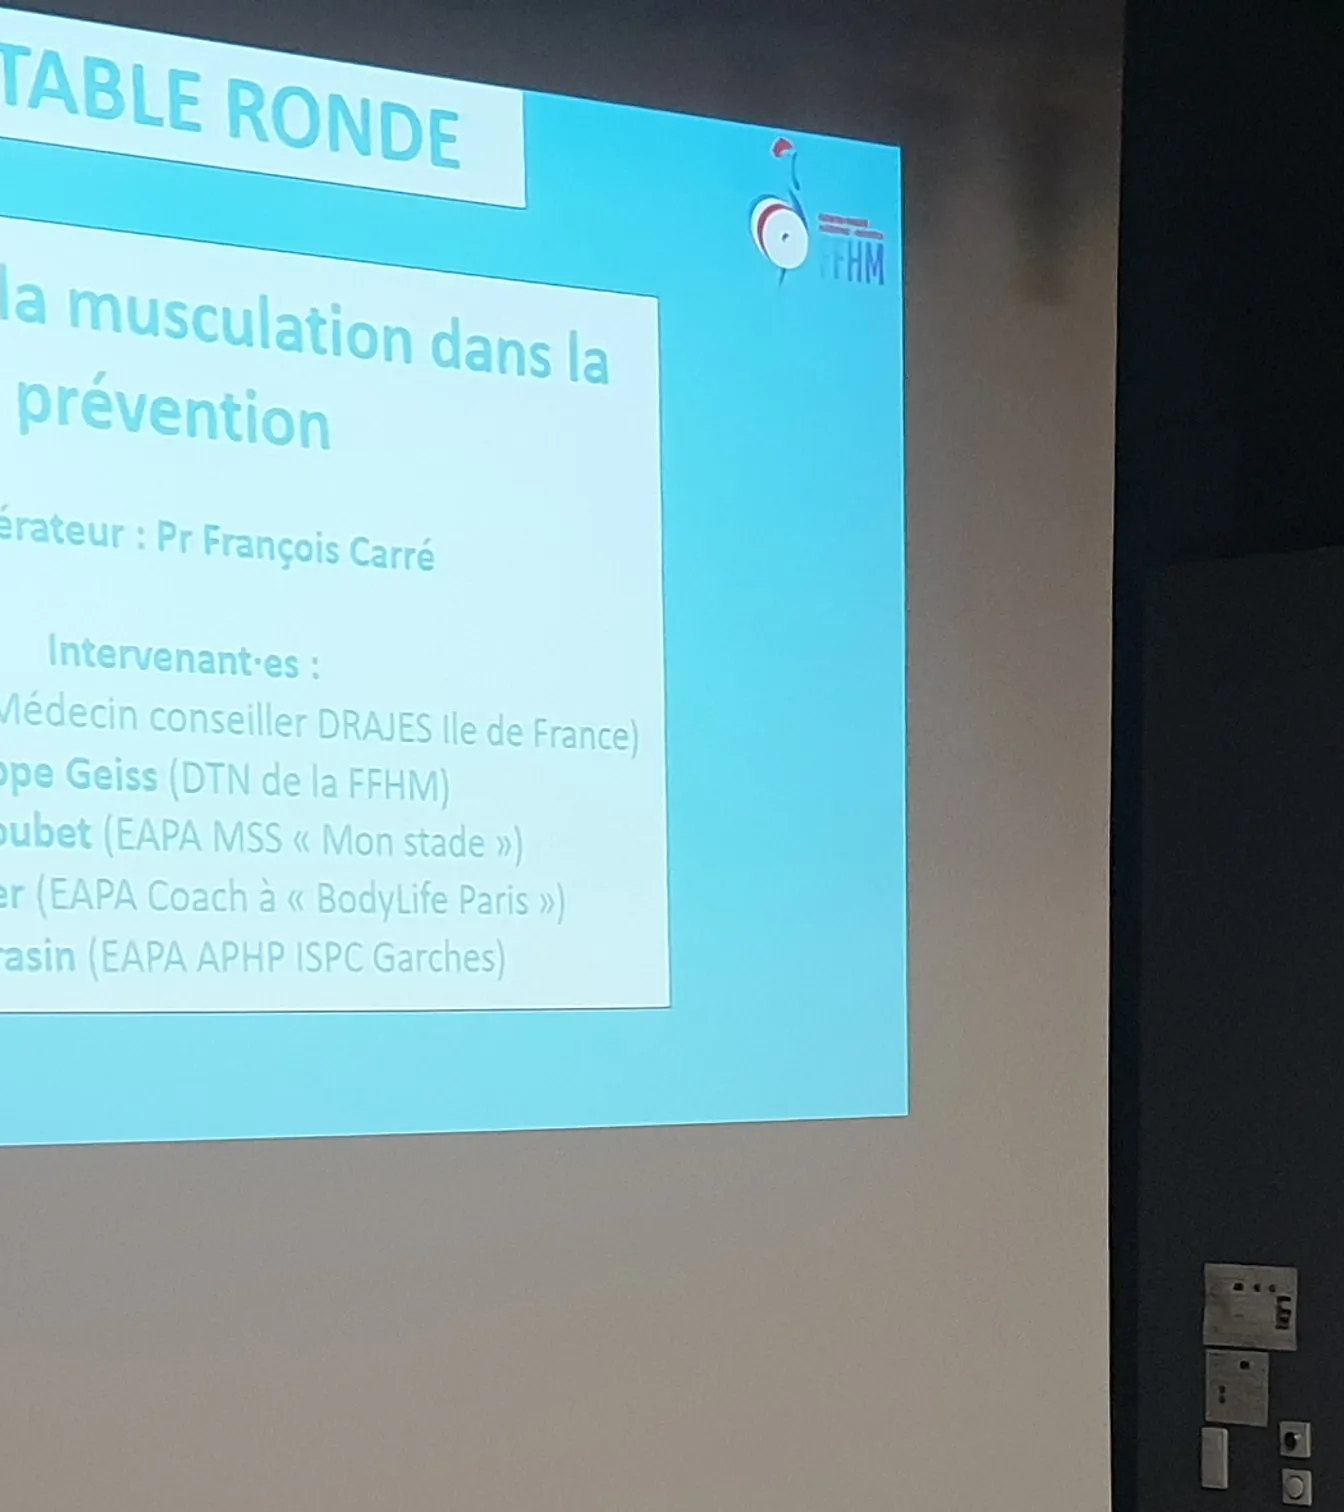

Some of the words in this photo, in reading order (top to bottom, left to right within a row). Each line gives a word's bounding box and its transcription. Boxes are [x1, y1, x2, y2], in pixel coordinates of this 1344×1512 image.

[227, 78, 461, 169] RONDE
[69, 285, 413, 366] musculation
[431, 315, 552, 380] dans
[568, 329, 610, 385] la
[17, 371, 333, 451] prévention
[157, 520, 193, 554] Pr
[203, 523, 341, 571] François
[350, 533, 435, 573] Carré
[150, 702, 308, 738] conseiller
[318, 707, 432, 744] DRAJES
[487, 714, 524, 748] de
[534, 718, 639, 760] France)
[66, 755, 157, 792] Geiss
[170, 757, 250, 801] (DTN
[262, 760, 301, 797] de
[311, 763, 337, 798] la
[349, 766, 449, 809] FFHM)
[104, 813, 200, 859] (EAPA
[213, 821, 282, 854] MSS
[323, 823, 393, 857] Mon
[404, 826, 485, 858] stade
[37, 873, 137, 920] (EAPA
[147, 880, 248, 914] Coach
[259, 877, 276, 914] à
[318, 880, 448, 923] BodyLife
[460, 885, 528, 917] Paris
[89, 936, 186, 982] (EAPA
[198, 941, 285, 973] APHP
[297, 941, 364, 973] ISPC
[373, 939, 505, 981] Garches)
